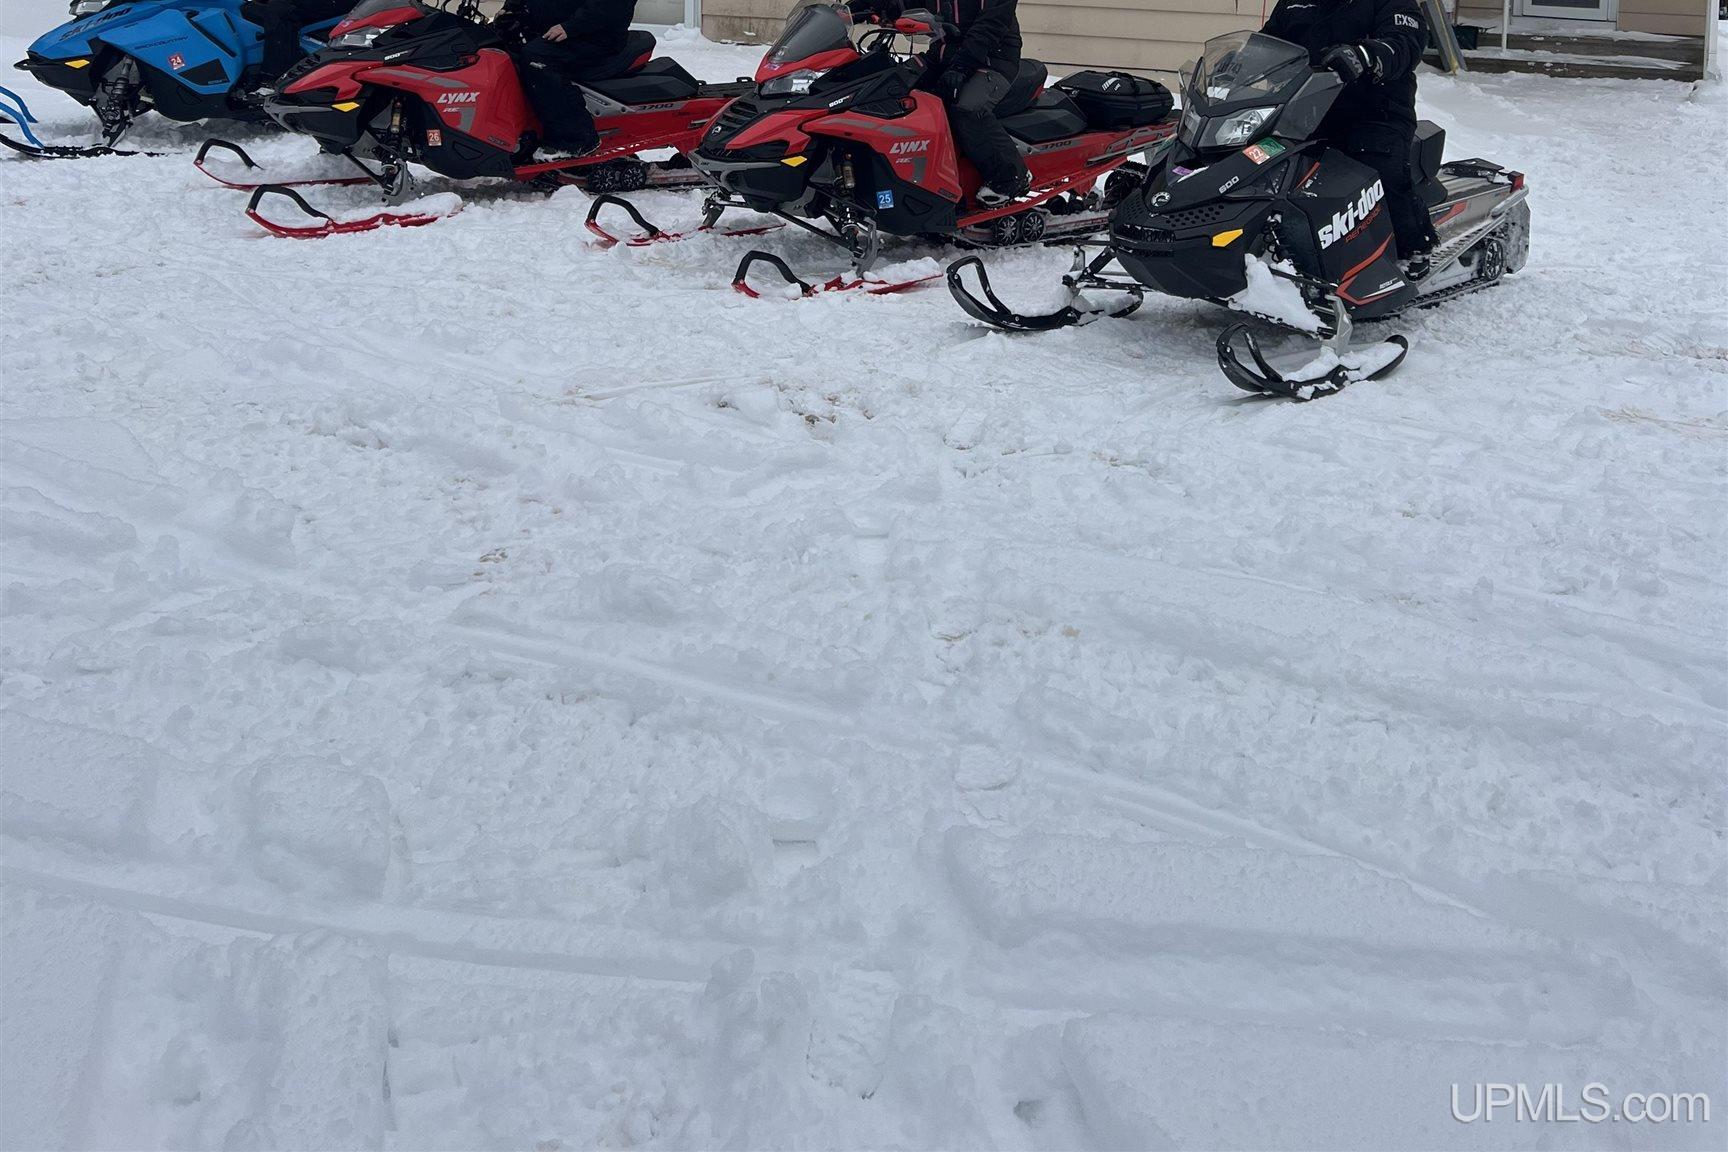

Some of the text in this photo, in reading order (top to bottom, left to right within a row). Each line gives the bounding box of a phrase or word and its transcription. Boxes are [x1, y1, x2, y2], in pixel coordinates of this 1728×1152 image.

[170, 56, 182, 67] 24
[437, 92, 480, 104] LYNX
[428, 133, 440, 142] 26
[889, 140, 930, 154] LYNX
[1249, 148, 1263, 159] 22
[1219, 176, 1239, 194] 600
[879, 194, 891, 204] 25
[1317, 179, 1385, 250] ski-doo
